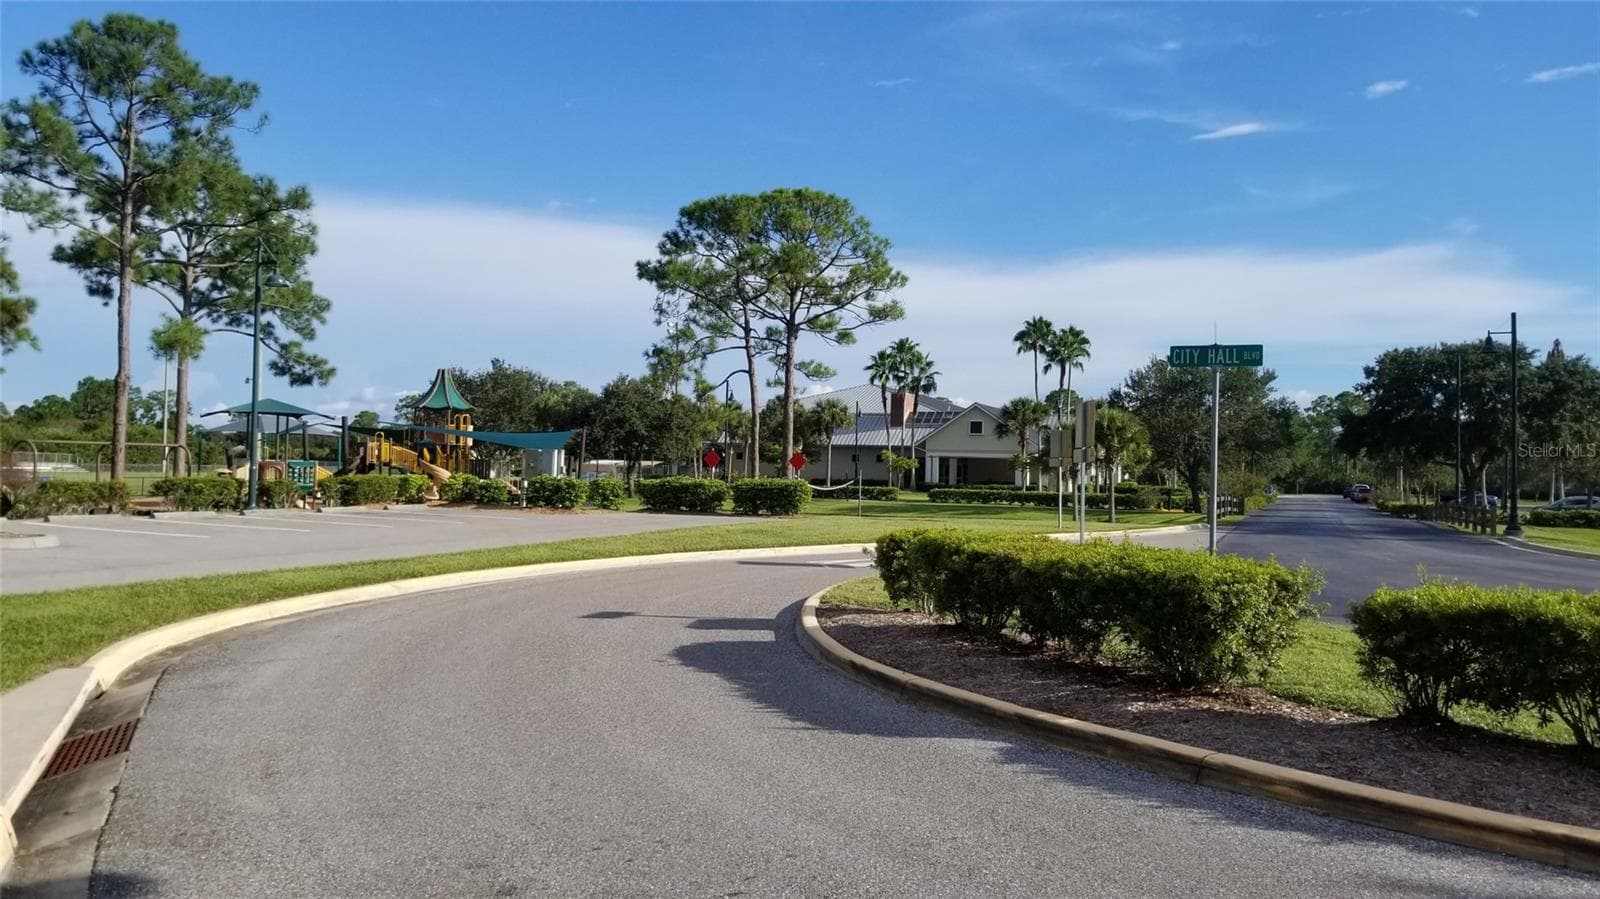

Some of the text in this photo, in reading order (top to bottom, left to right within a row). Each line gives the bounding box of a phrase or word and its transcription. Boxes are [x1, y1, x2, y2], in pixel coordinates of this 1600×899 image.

[1173, 348, 1260, 364] CITY HALL BLVD
